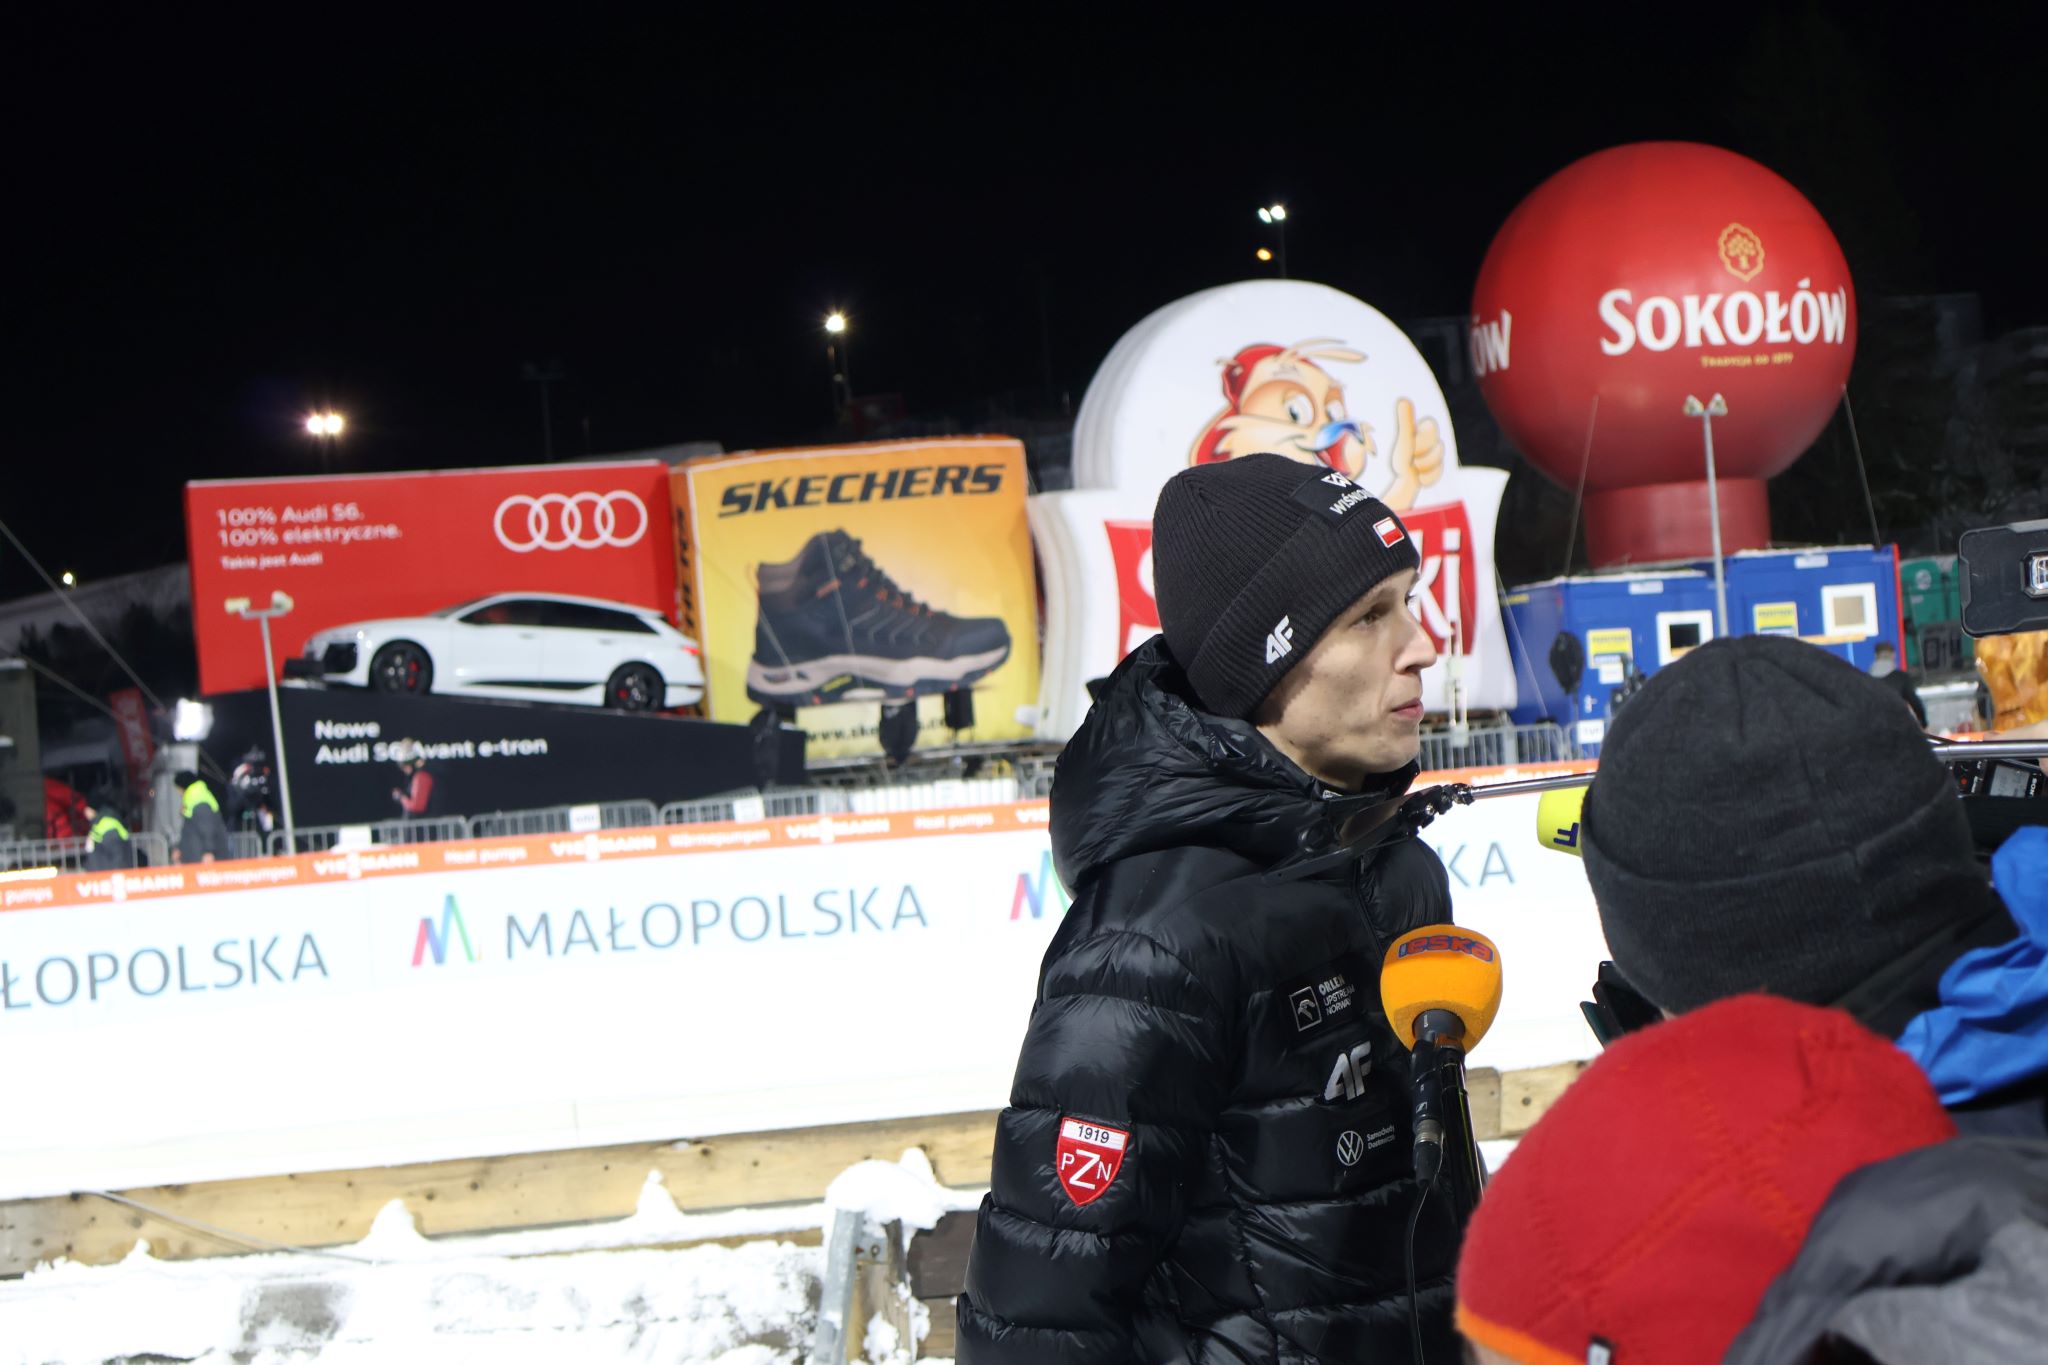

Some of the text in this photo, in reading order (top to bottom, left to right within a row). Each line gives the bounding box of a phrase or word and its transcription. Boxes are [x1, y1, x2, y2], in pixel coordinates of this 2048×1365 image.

[1599, 278, 1847, 356] SOKOŁÓW
[718, 464, 1006, 519] SKECHERS
[217, 507, 277, 526] 100%
[281, 504, 328, 524] Audi
[218, 527, 279, 547] 100%
[289, 551, 324, 566] Audi
[314, 719, 380, 740] Nowe
[315, 742, 369, 764] Audi
[478, 738, 548, 758] e-tron
[505, 884, 928, 959] MAŁOPOLSKA
[1318, 974, 1346, 996] ORLEN
[1078, 1125, 1110, 1144] 1919
